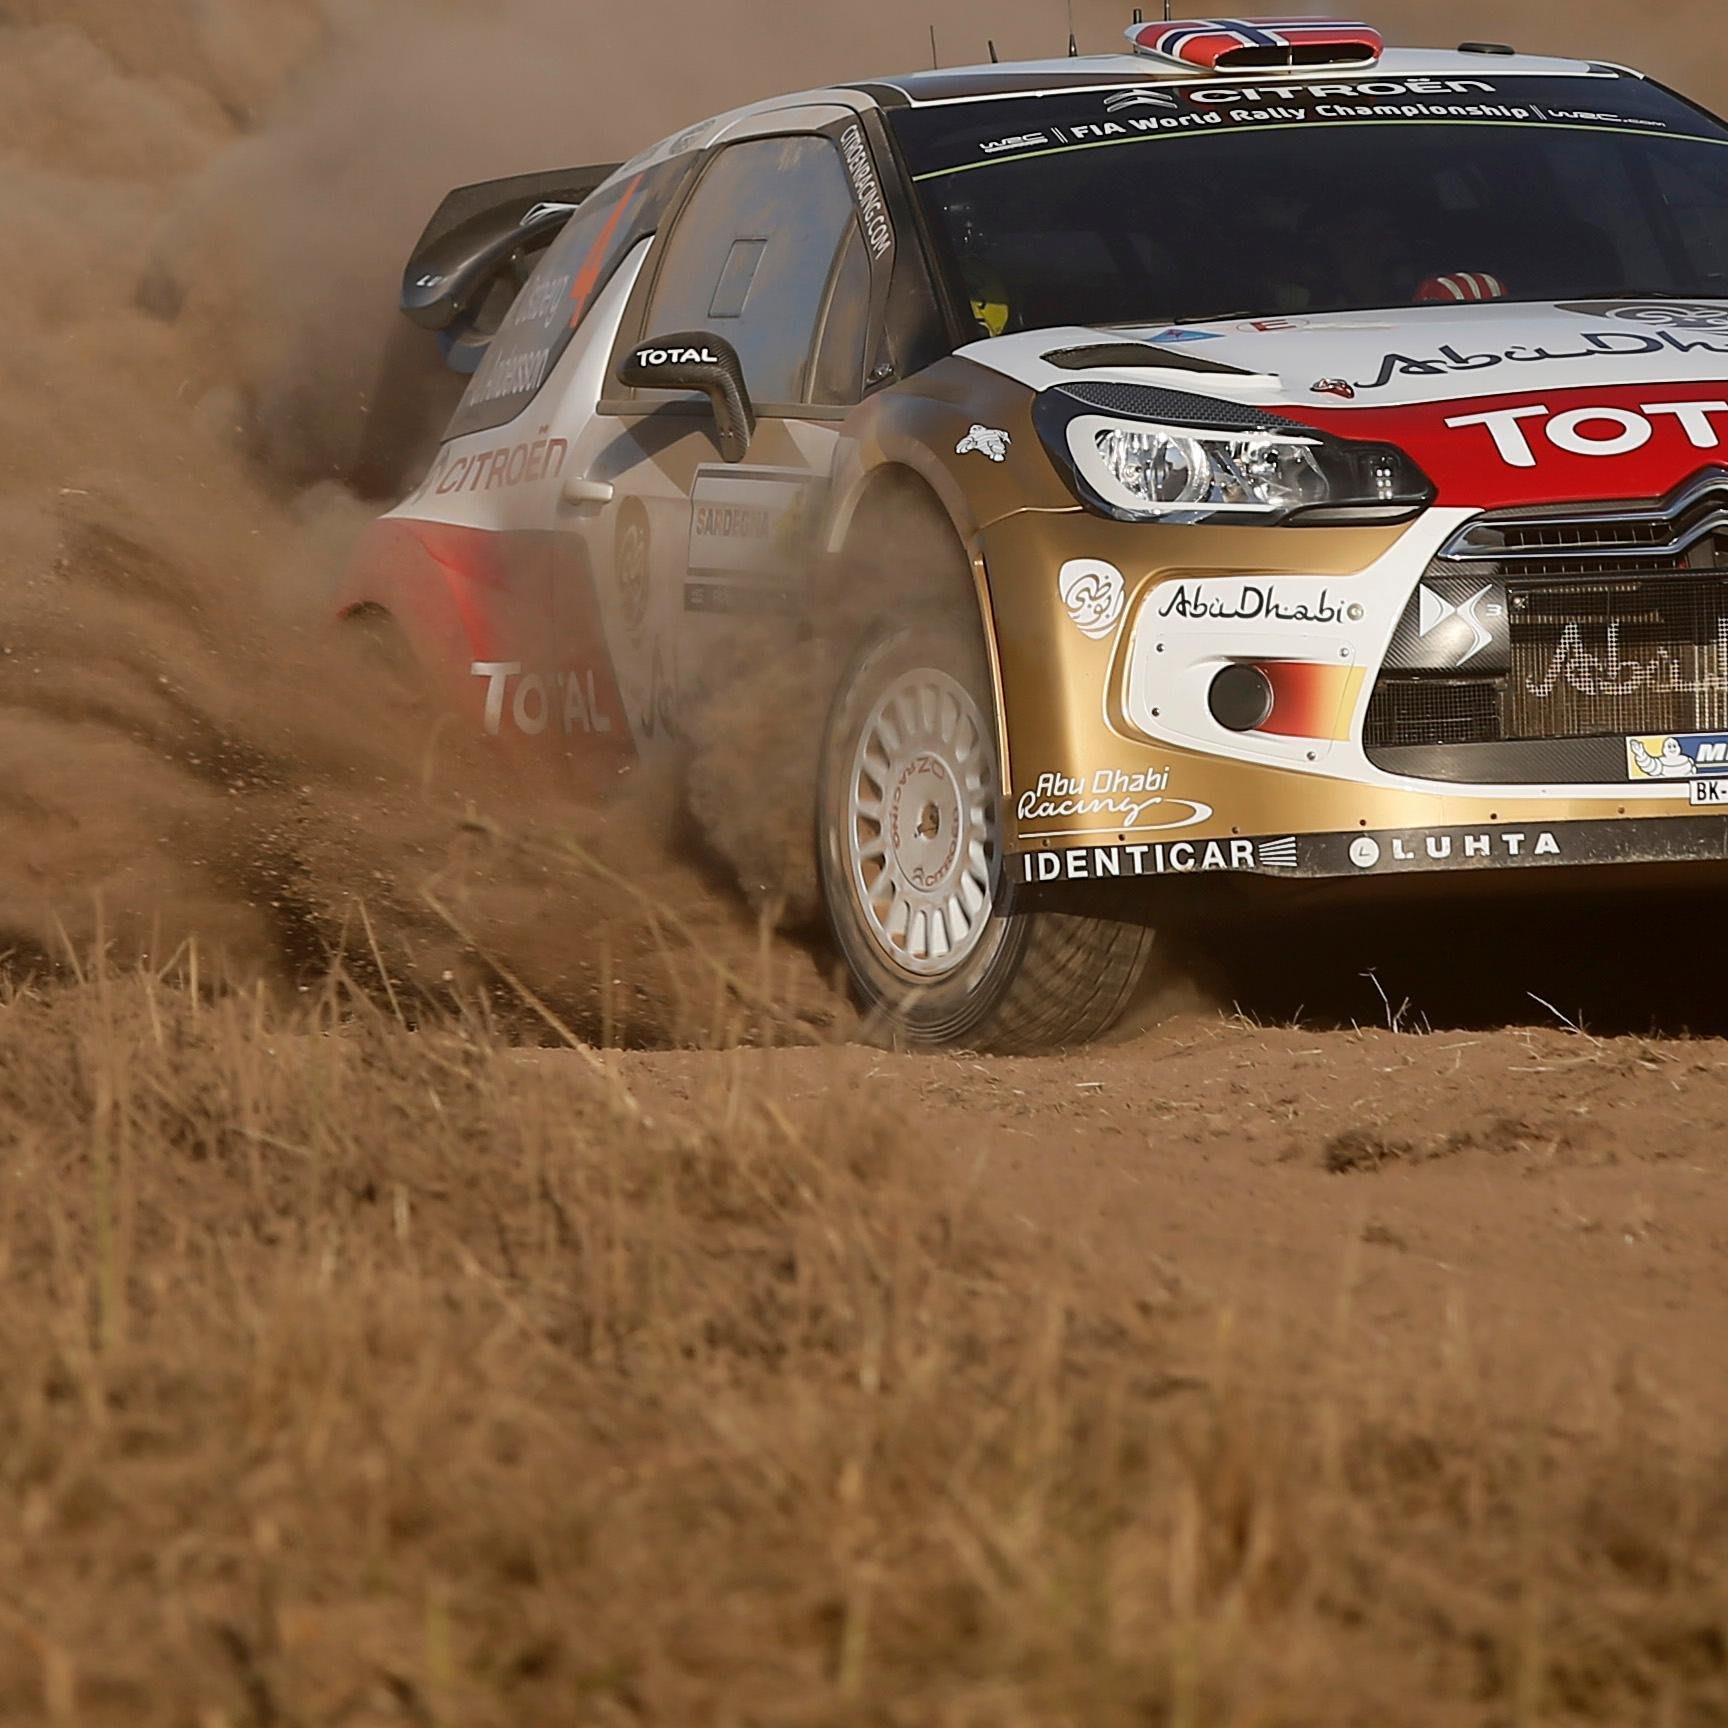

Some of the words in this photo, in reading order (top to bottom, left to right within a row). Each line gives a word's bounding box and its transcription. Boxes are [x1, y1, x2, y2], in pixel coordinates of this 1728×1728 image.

[979, 132, 1047, 152] WRC
[1070, 122, 1126, 139] FIA
[1128, 111, 1222, 130] World
[1229, 104, 1306, 122] Rally
[1314, 103, 1530, 120] Championship
[840, 123, 891, 261] CITROENRACING.COM
[636, 348, 718, 367] TOTAL
[471, 660, 612, 736] TOAL
[1035, 773, 1083, 798] Abu
[1092, 767, 1170, 794] Dhabi
[1017, 791, 1164, 828] Racing
[1024, 839, 1256, 882] IDENTICAR
[1391, 831, 1561, 860] LUHTA
